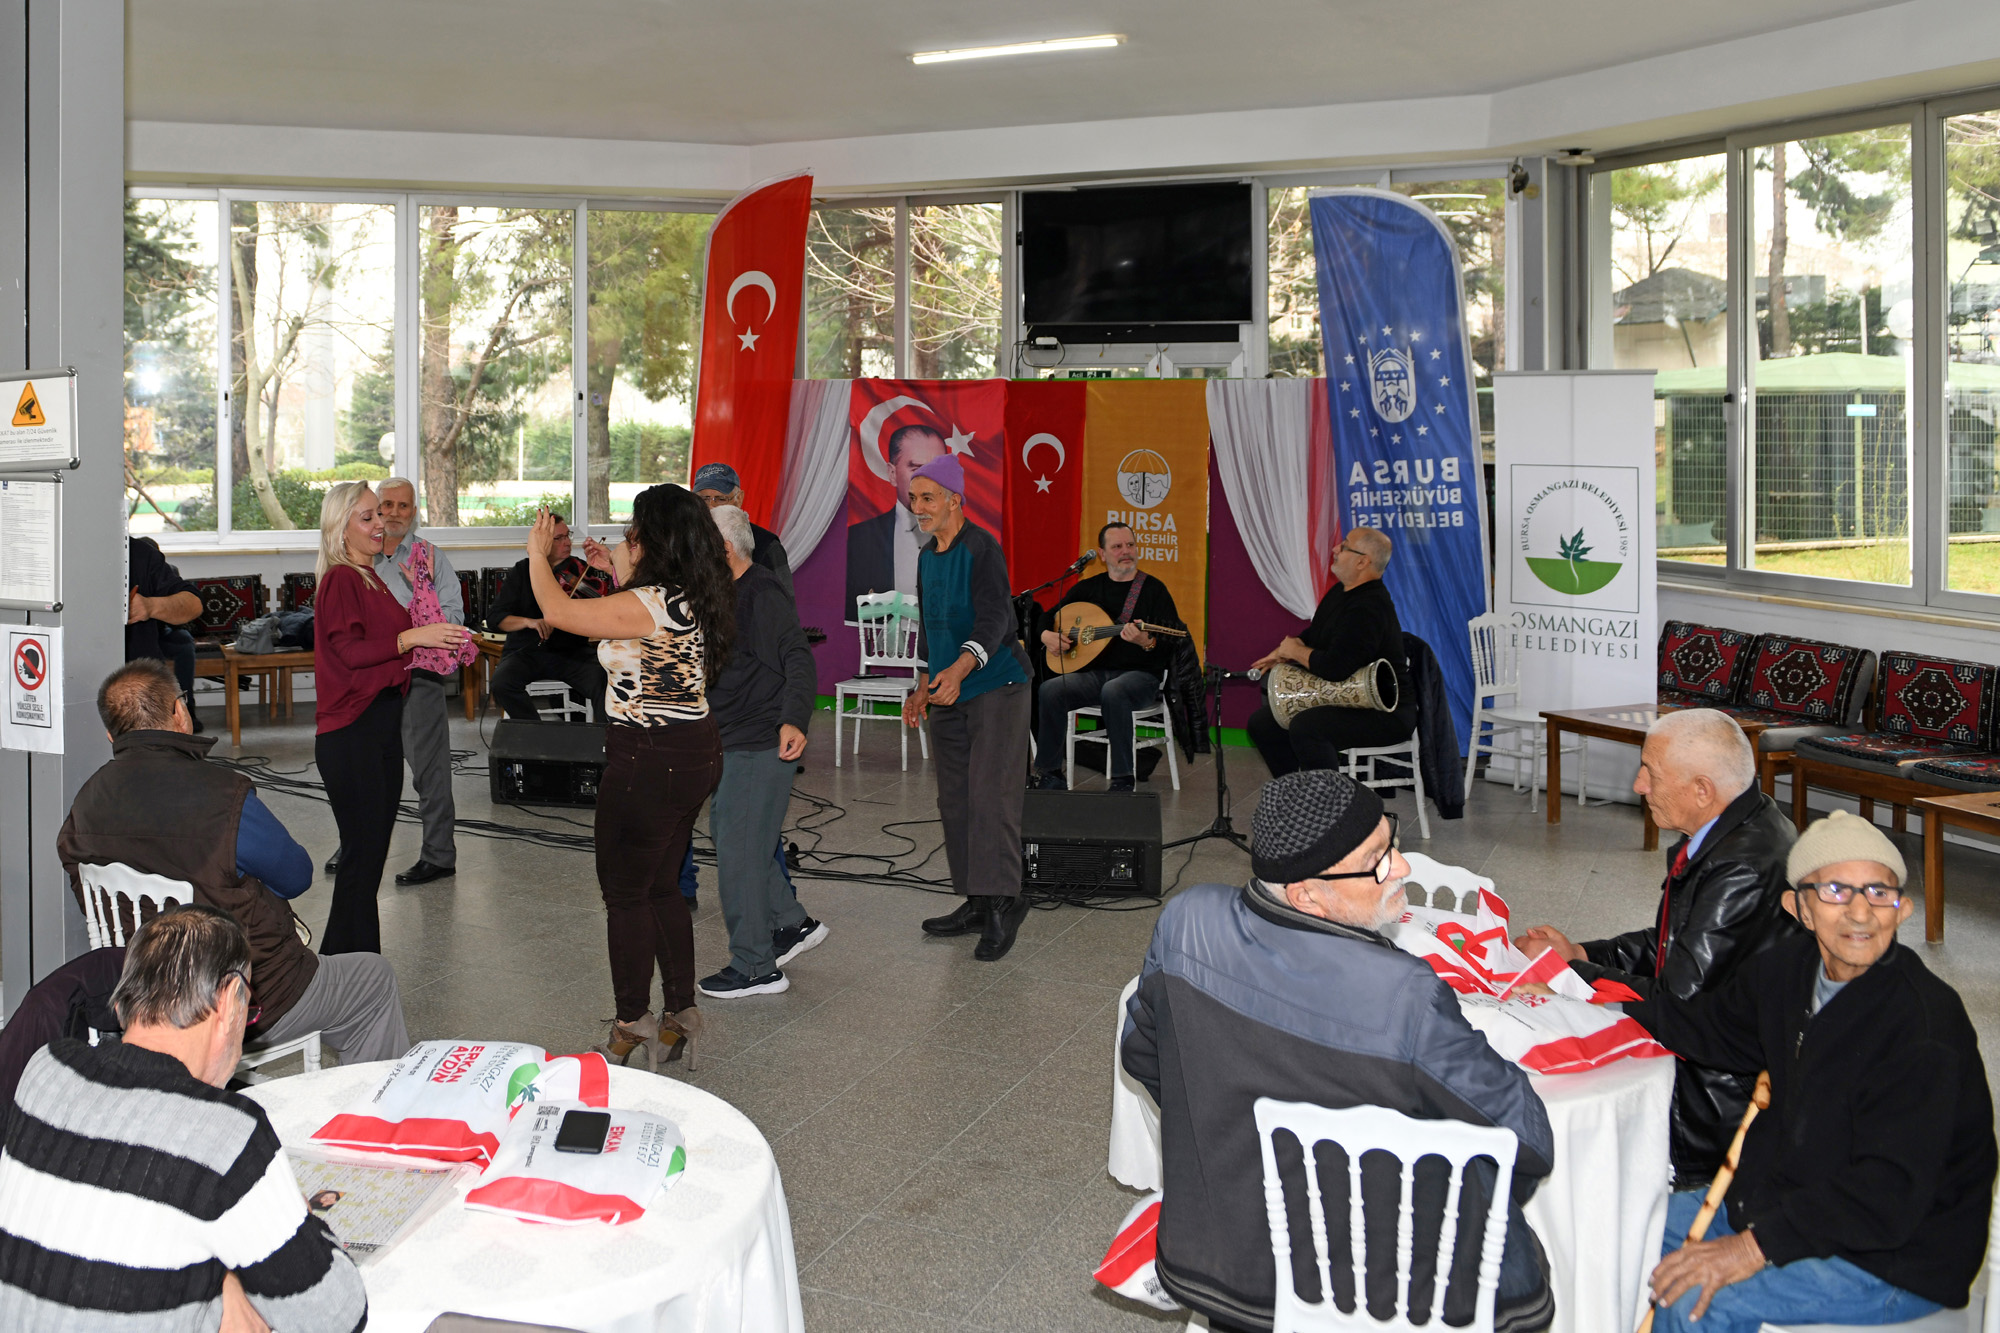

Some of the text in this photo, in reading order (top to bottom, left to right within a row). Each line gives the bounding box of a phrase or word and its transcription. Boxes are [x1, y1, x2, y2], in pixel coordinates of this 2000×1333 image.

[1107, 510, 1177, 532] BURSA
[1521, 478, 1629, 557] BURSA OSMANGAZİ BELEDİYESİ 1987
[1132, 530, 1178, 547] KŞEHİR
[1136, 546, 1179, 562] UREVİ
[1511, 611, 1638, 639] OSMANGAZİ
[431, 1045, 469, 1083] AYDIN
[446, 1045, 486, 1083] ERKAN
[603, 1126, 626, 1154] ERKAN
